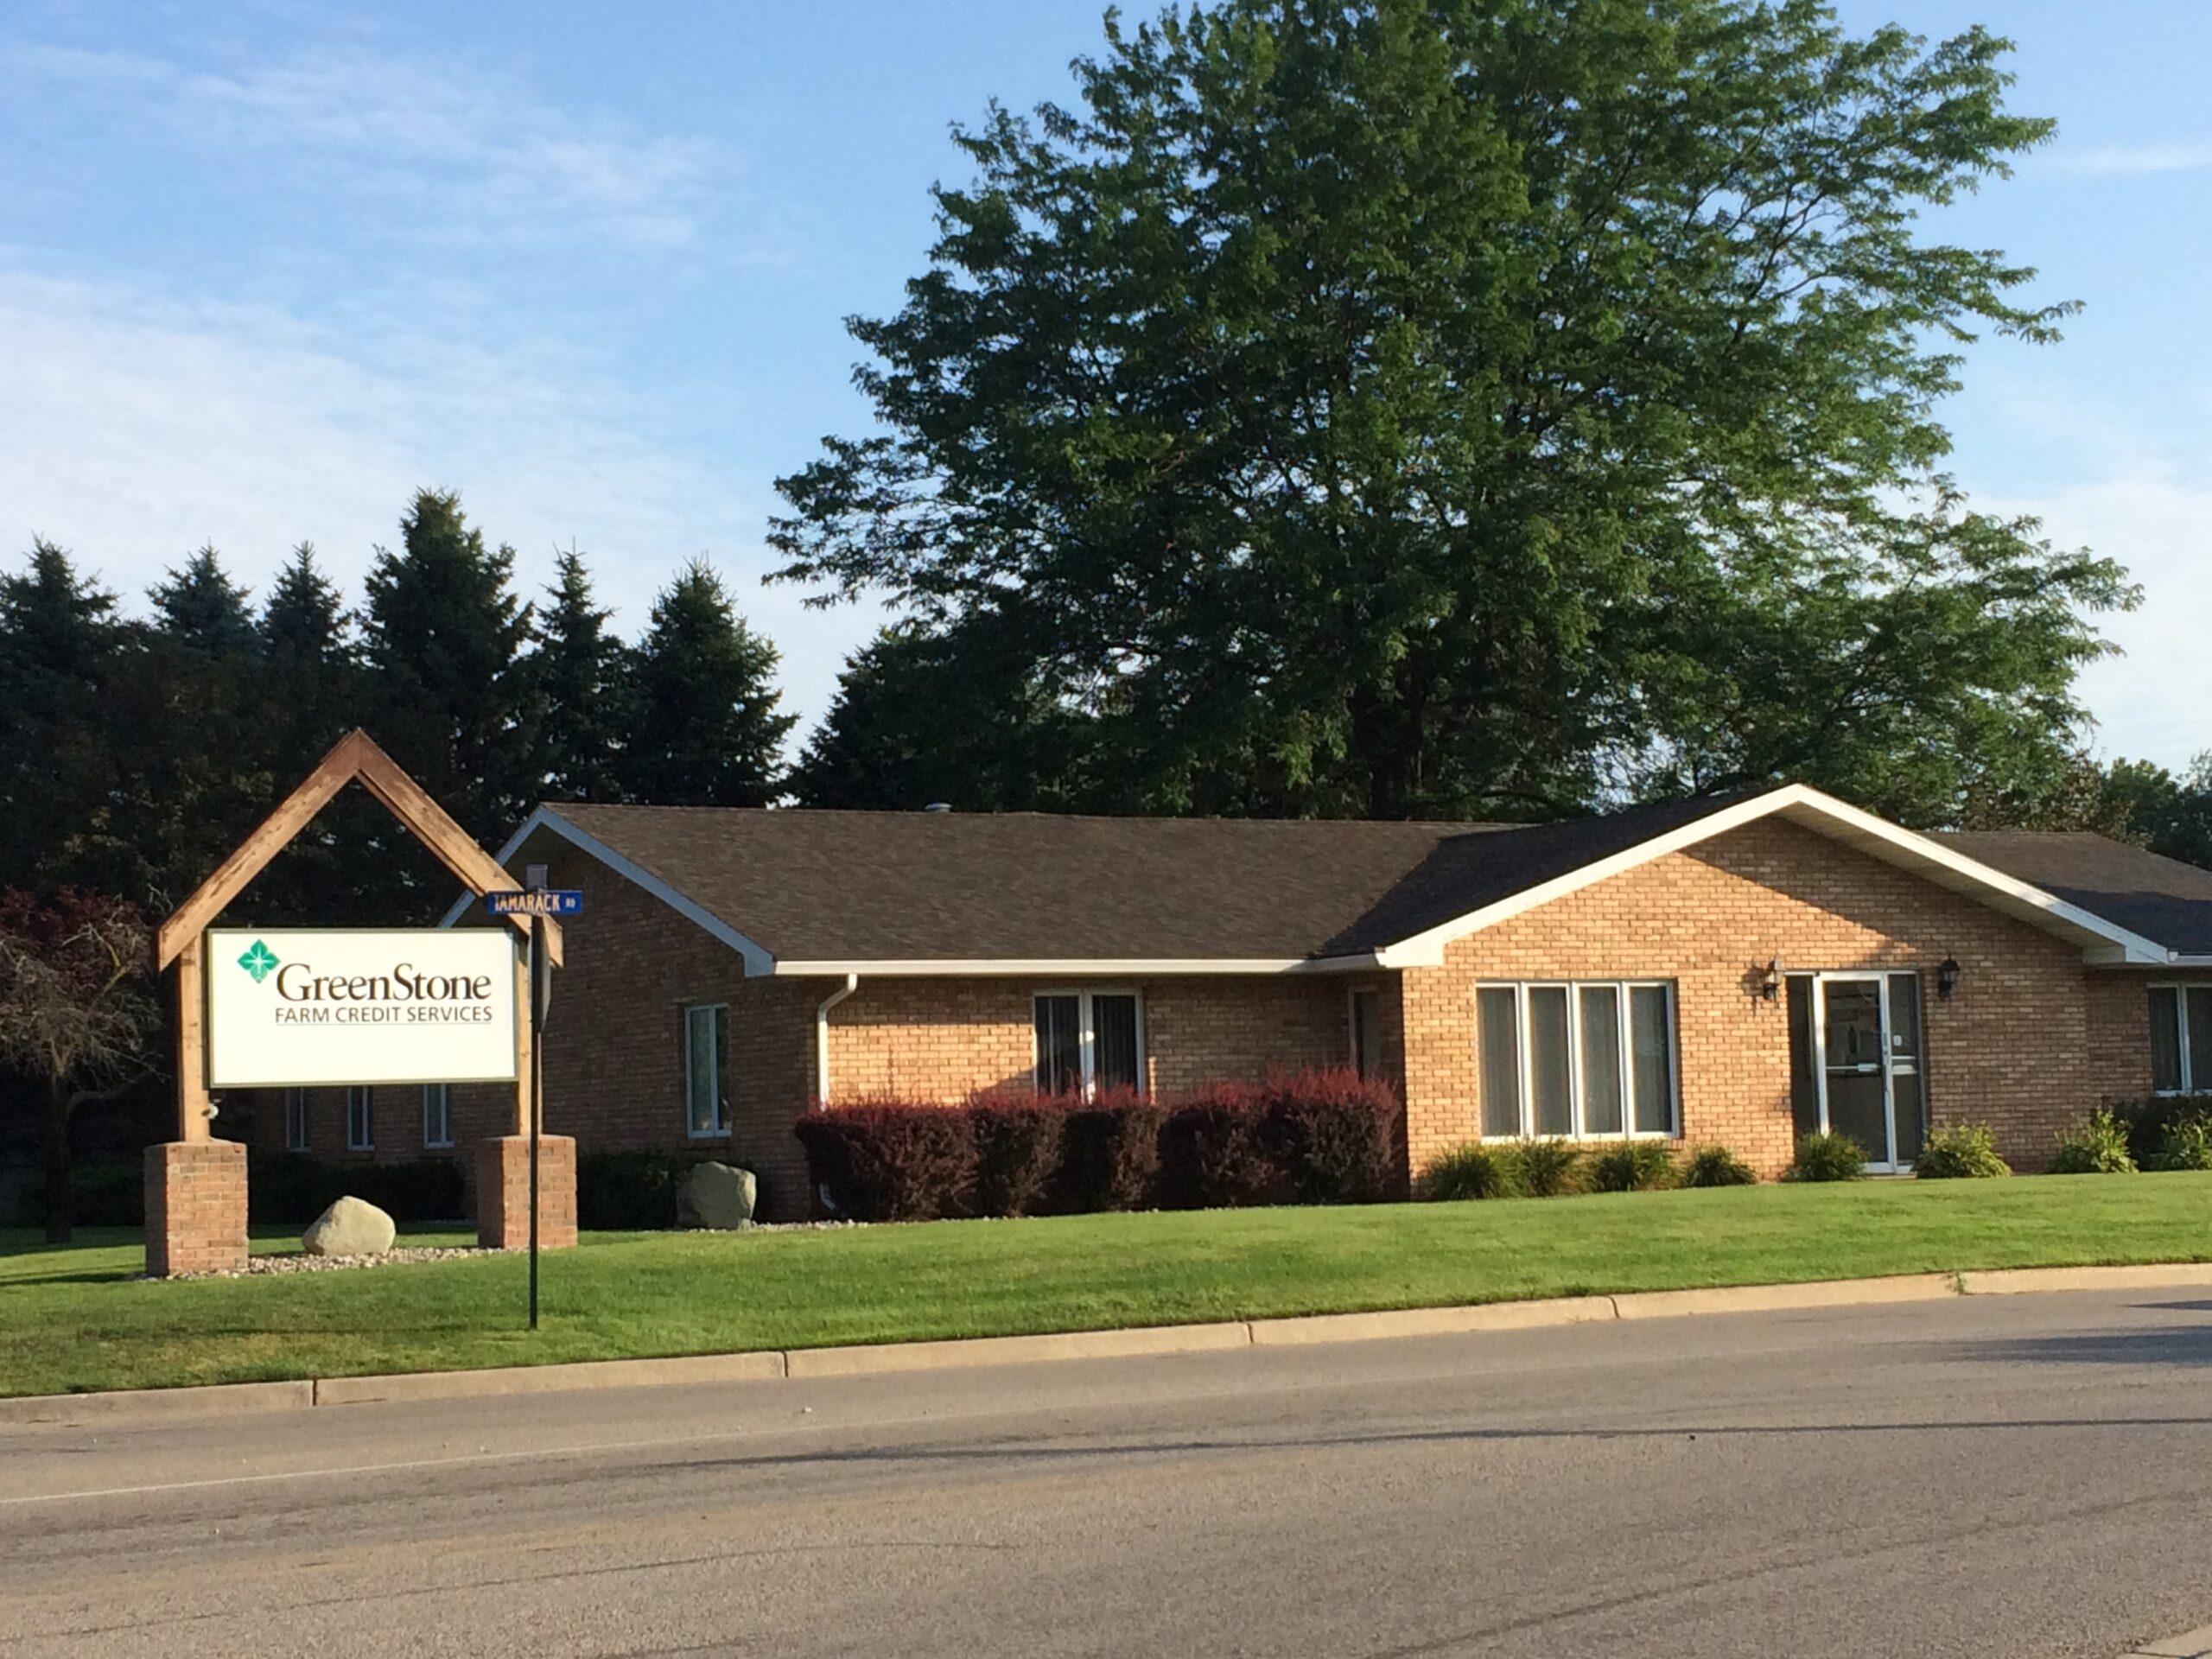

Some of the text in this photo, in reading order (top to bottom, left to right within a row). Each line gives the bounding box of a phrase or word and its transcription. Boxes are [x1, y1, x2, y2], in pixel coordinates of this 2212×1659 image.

[493, 893, 561, 912] TAMARACK
[276, 963, 492, 1001] GreenStone
[275, 1006, 493, 1023] FARM CREDIT SERVICES
